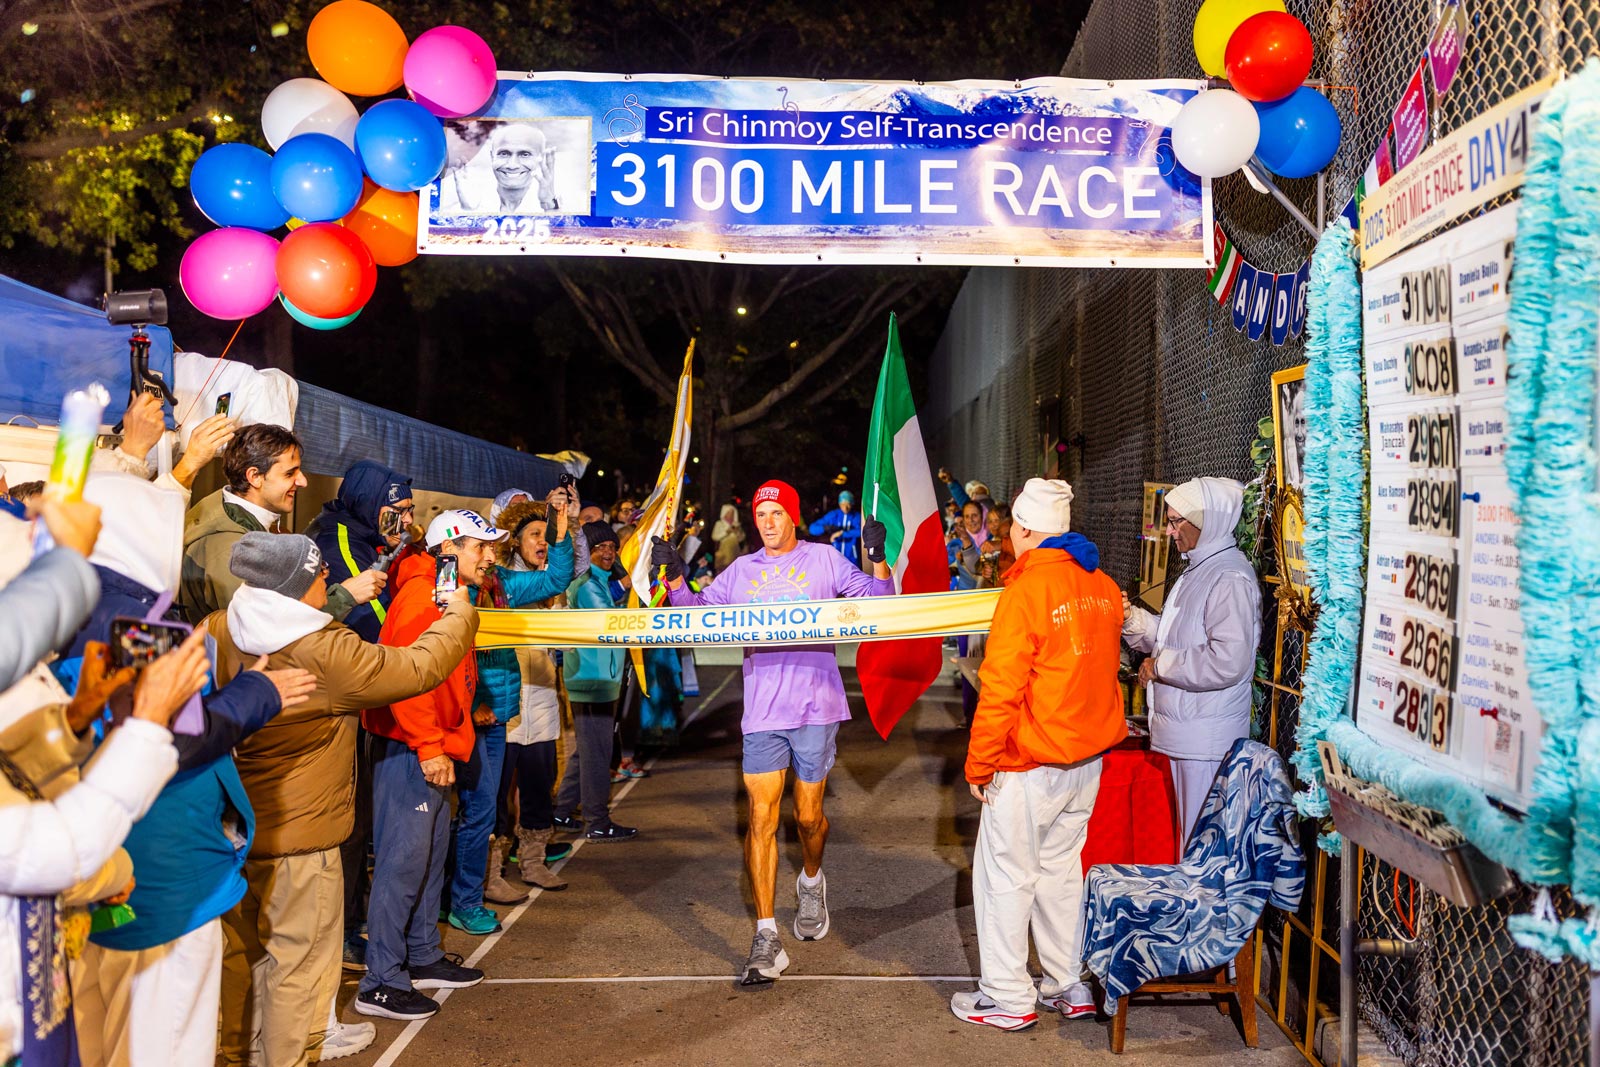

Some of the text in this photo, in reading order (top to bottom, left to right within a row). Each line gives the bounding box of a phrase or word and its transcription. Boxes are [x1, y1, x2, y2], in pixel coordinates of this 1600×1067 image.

[658, 111, 1112, 144] Sri Chinmoy Self-Transcendence
[610, 153, 1161, 219] 3100 MILE RACE
[1364, 208, 1384, 250] 2025
[1408, 174, 1432, 221] MILE
[1433, 153, 1464, 206] RACE
[1469, 117, 1509, 193] DAY
[484, 218, 550, 243] 2025
[1401, 268, 1449, 323] 3100
[1408, 416, 1450, 466] 2967
[456, 509, 498, 535] ITALIA
[1408, 480, 1452, 530] 2894
[1404, 554, 1450, 612] 2869
[597, 624, 879, 645] SELF-TRANSCENDENCE 3100 MILE RACE
[608, 614, 647, 632] 2025
[652, 612, 692, 631] SRI
[701, 606, 823, 629] CHINMOY
[1400, 620, 1450, 689] 2866
[1393, 681, 1446, 749] 2833
